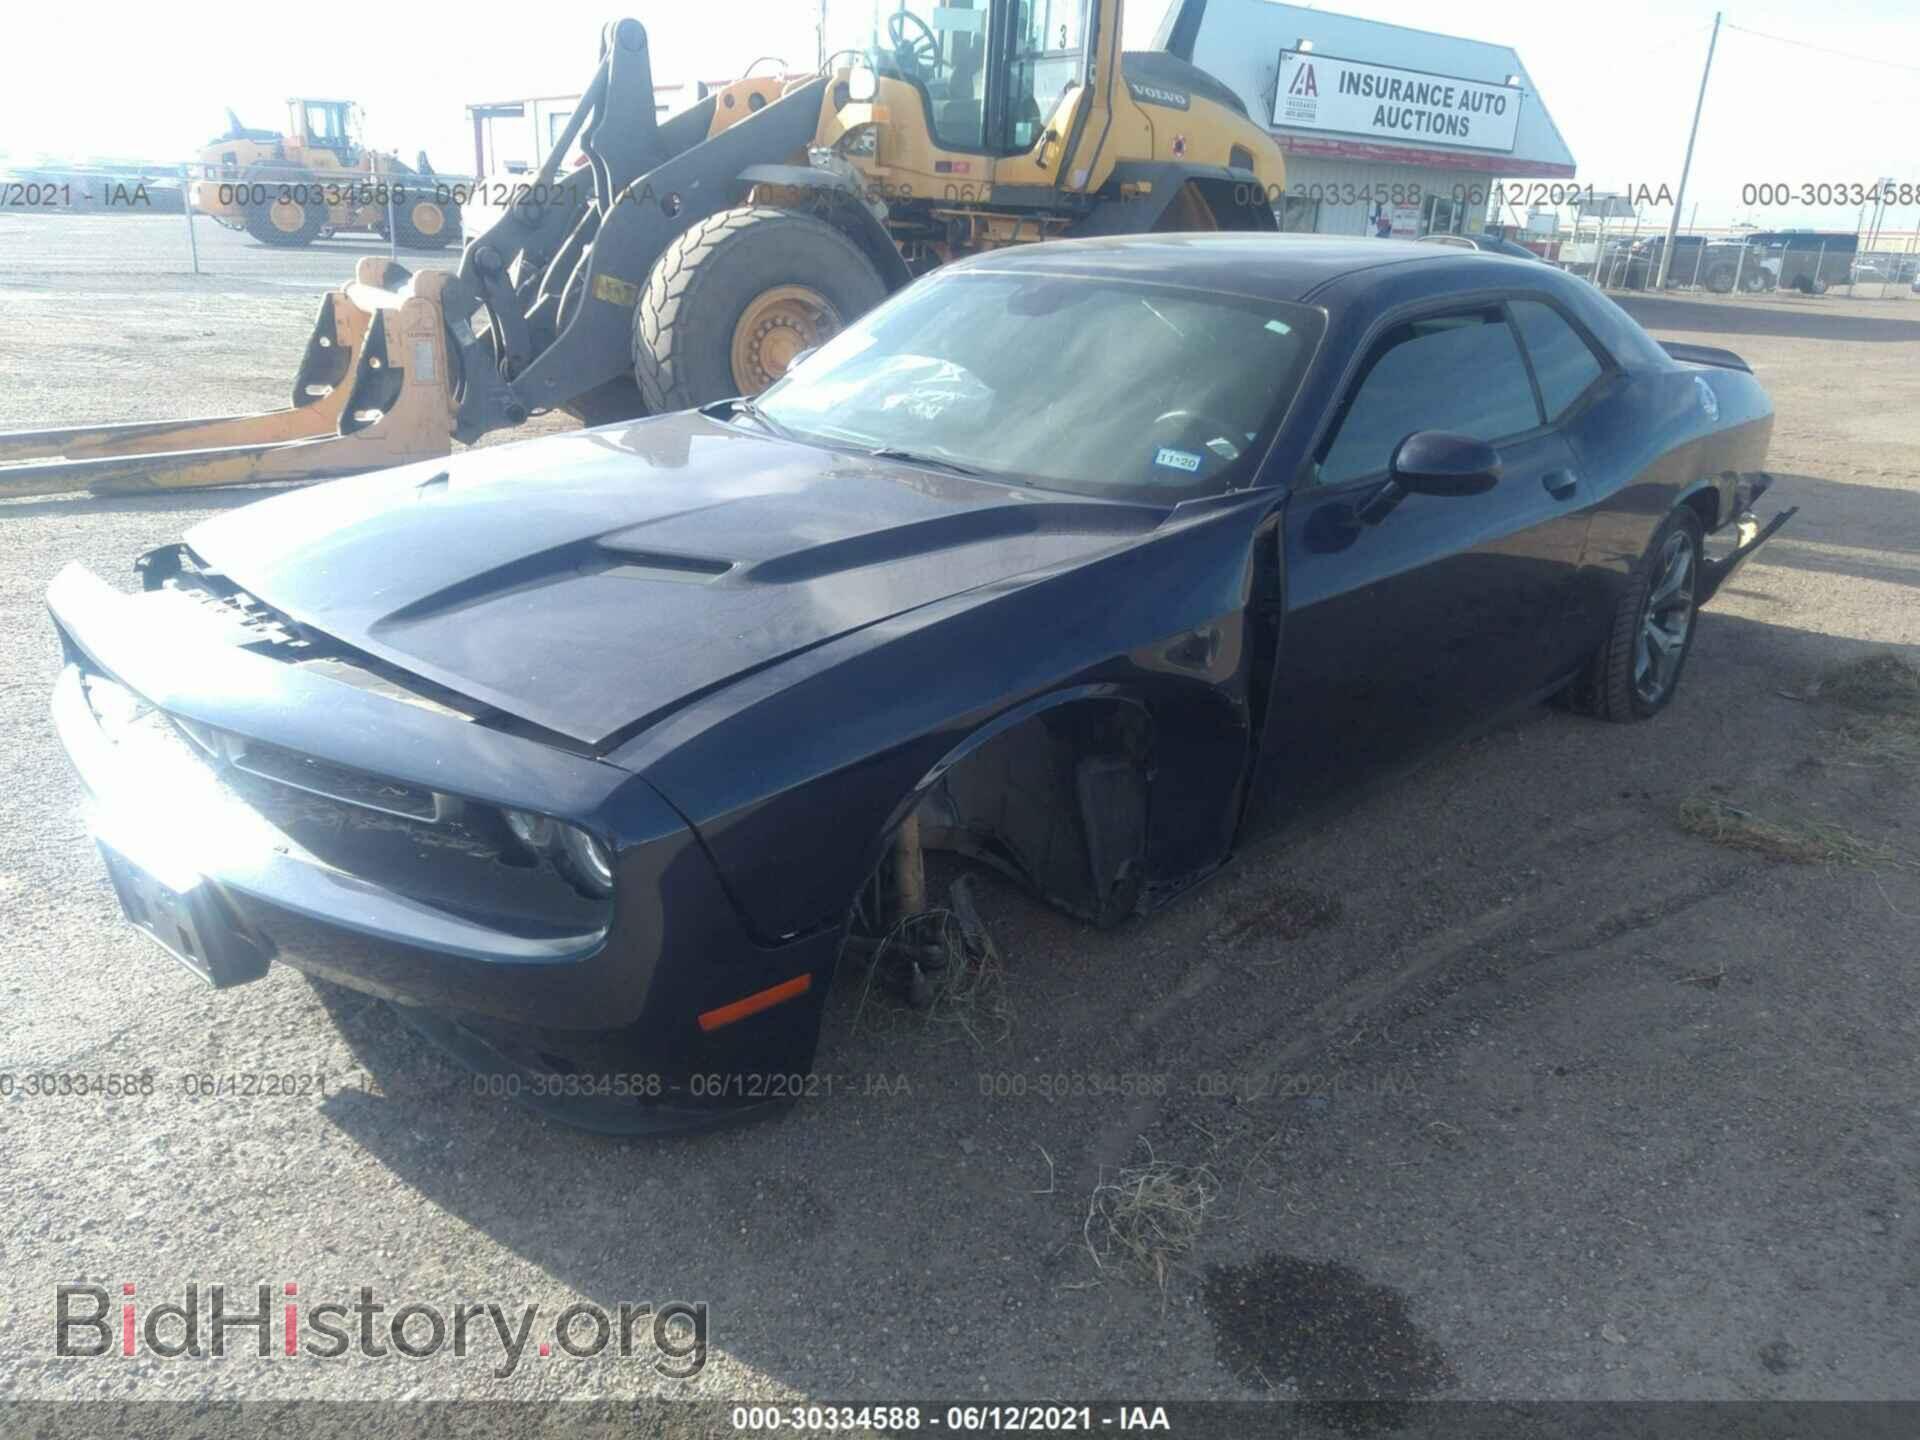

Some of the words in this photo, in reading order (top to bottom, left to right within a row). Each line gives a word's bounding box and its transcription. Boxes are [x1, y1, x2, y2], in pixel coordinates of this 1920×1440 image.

[1131, 83, 1186, 105] VOLVO
[1338, 70, 1455, 108] INSURANCE
[1458, 90, 1506, 116] AUTO
[1372, 105, 1470, 137] AUCTIONS
